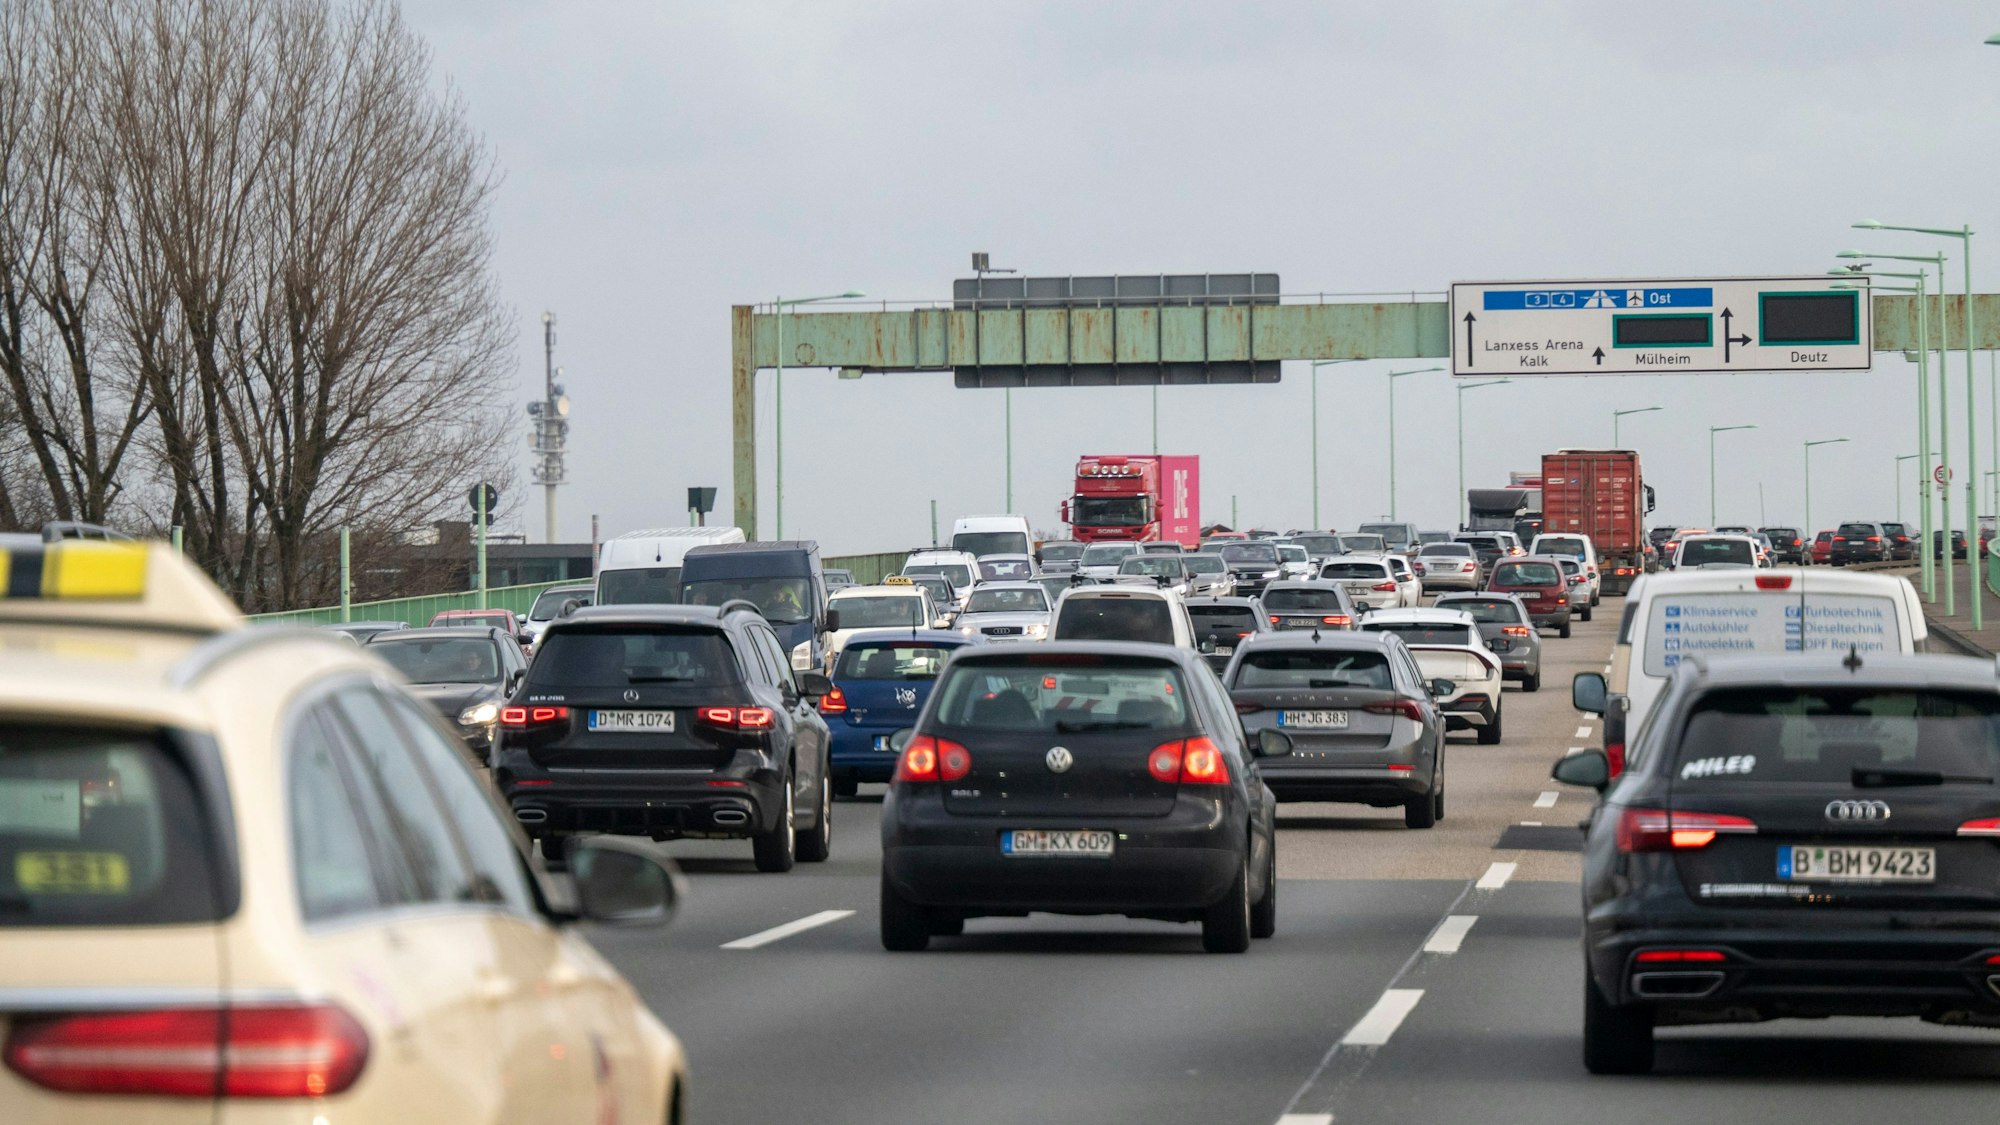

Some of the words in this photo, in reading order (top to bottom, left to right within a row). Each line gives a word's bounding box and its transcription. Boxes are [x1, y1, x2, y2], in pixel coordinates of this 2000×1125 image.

[1534, 295, 1540, 304] 3
[1560, 295, 1566, 304] 4
[1649, 292, 1672, 304] Ost
[1485, 340, 1539, 351] Lanxess
[1546, 339, 1584, 351] Arena
[1519, 355, 1549, 367] Kalk
[1636, 352, 1691, 365] Mülheim
[1791, 351, 1828, 363] Deutz
[1683, 605, 1758, 617] Klimaservice
[1805, 605, 1882, 618] Turbotechnik
[1804, 622, 1883, 634] Dieseltechnik
[1683, 637, 1755, 649] Autoelektrik
[1804, 638, 1828, 649] DPF
[599, 713, 607, 726] D
[616, 713, 634, 727] MR
[637, 713, 672, 728] 1074
[1285, 712, 1300, 723] HH
[1308, 712, 1323, 724] JG
[1325, 712, 1346, 724] 383
[1681, 754, 1757, 780] MILES
[1014, 832, 1037, 849] GM
[1049, 832, 1073, 850] KX
[1077, 833, 1110, 850] 609
[1794, 850, 1809, 874] B
[1828, 850, 1861, 875] BM
[1867, 851, 1930, 876] 9423
